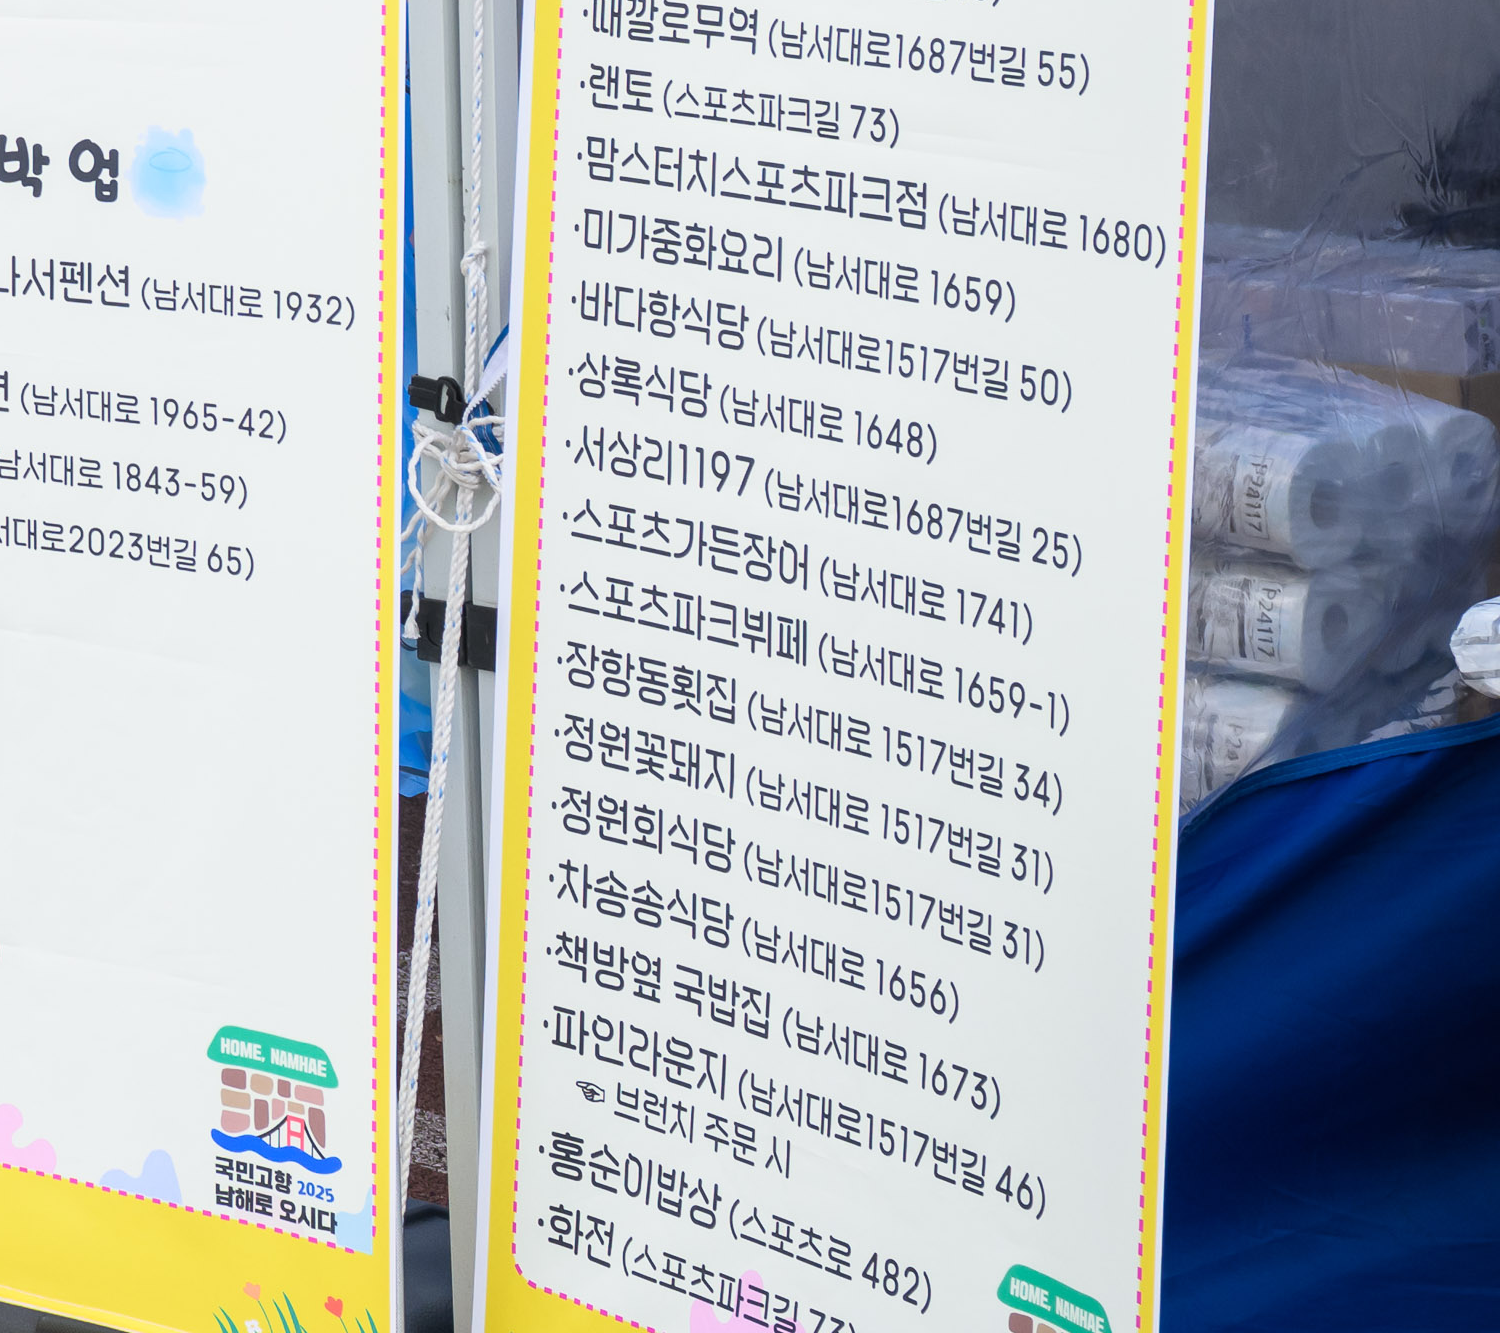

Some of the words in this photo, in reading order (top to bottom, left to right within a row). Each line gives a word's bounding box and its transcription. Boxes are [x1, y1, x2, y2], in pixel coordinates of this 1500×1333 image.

[663, 79, 840, 140] (스포츠파크길
[850, 104, 900, 149] 73)
[141, 276, 264, 318] (남서대로
[273, 290, 355, 331] 1932)
[20, 382, 141, 425] (남서대로
[150, 396, 287, 445] 1965-42)
[207, 543, 254, 582] 65)
[747, 690, 873, 759] (남서대로
[882, 725, 1003, 799] 1517번길
[1014, 762, 1063, 816] 34)
[220, 1037, 266, 1062] HOME,
[270, 1047, 327, 1078] NAMHAE
[673, 964, 771, 1040] 국밥집
[782, 1006, 909, 1085] (남서대로
[919, 1052, 1001, 1120] 1673)
[215, 1155, 293, 1195] 국민고향
[297, 1181, 335, 1203] 2025
[215, 1183, 273, 1218] 남해로
[279, 1198, 338, 1235] 오시다
[729, 1198, 853, 1281] (스포츠로
[861, 1252, 932, 1315] 482)
[1009, 1276, 1052, 1312] HOME,
